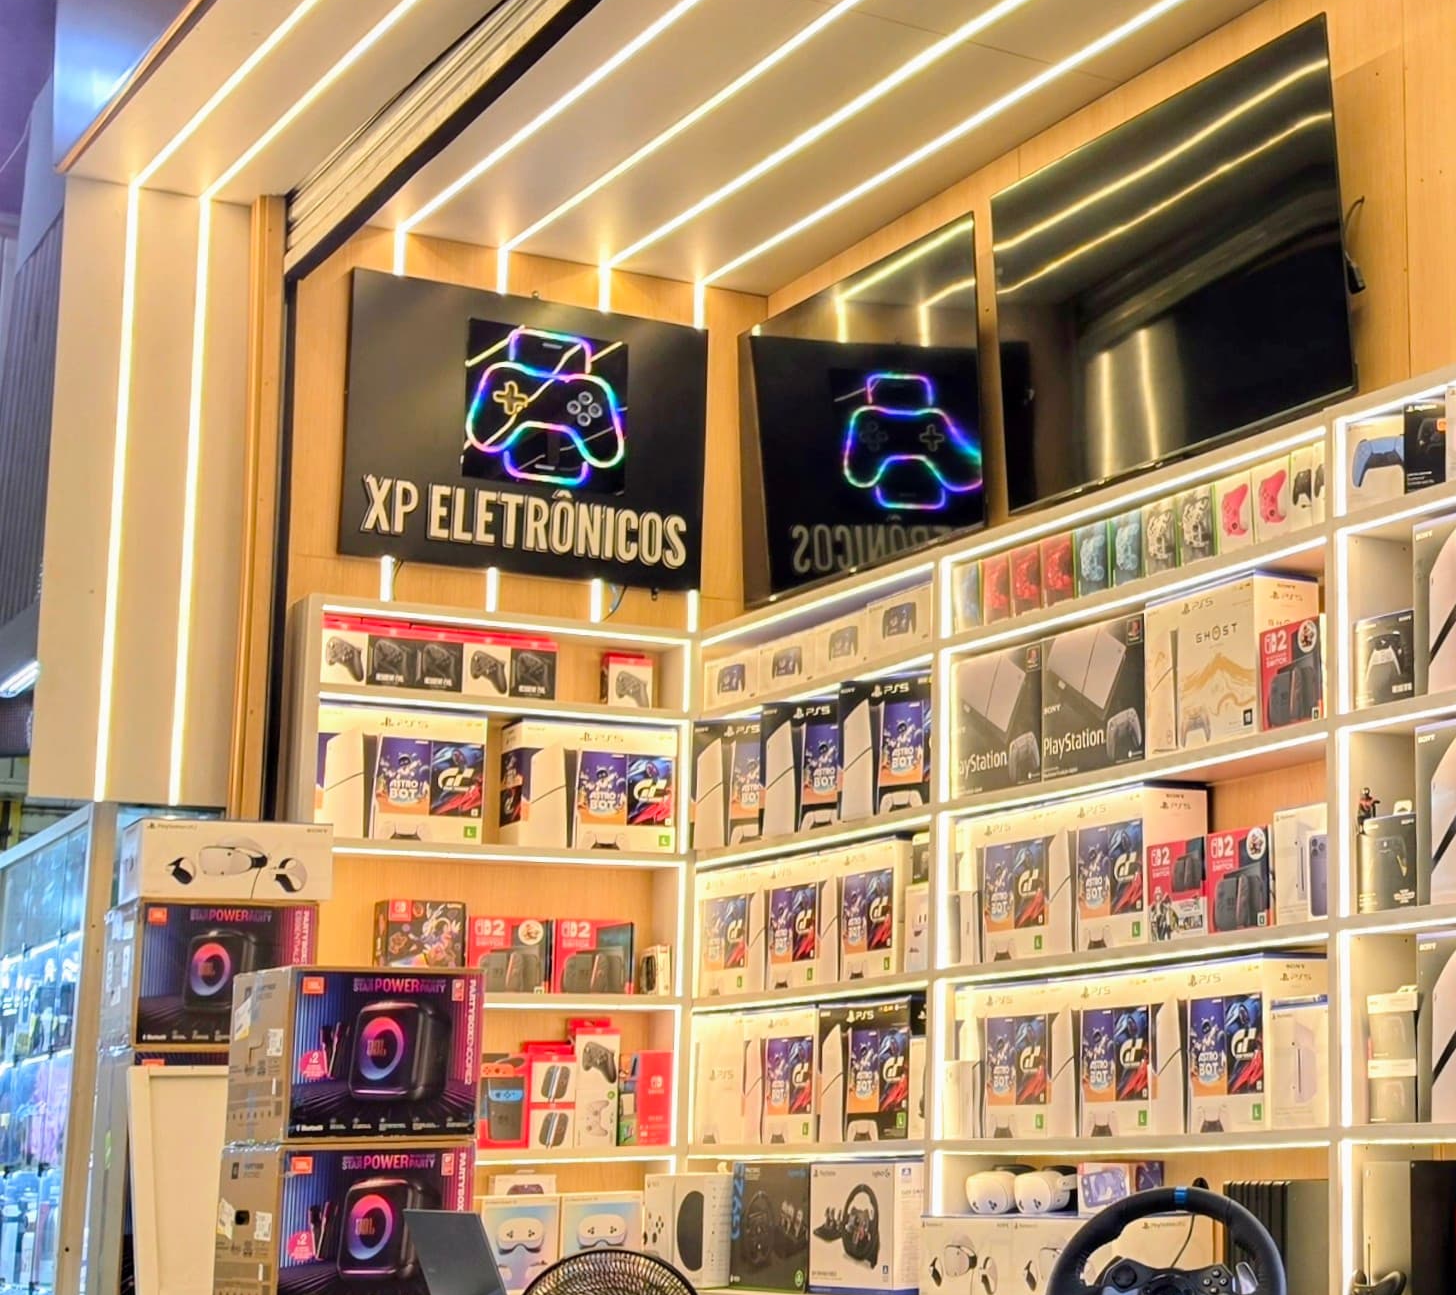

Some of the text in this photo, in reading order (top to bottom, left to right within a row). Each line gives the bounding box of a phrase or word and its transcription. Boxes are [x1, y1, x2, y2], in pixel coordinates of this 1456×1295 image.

[362, 474, 688, 570] XP ELETRÔNICOS
[1195, 623, 1238, 644] GHOST
[1277, 630, 1287, 651] 2
[884, 682, 910, 694] PS5
[804, 706, 831, 717] PS5
[1043, 728, 1106, 759] PlayStation
[891, 747, 914, 757] ASTRO
[891, 757, 914, 768] BOT
[958, 749, 1009, 779] ayStation
[813, 768, 835, 778] ASTRO
[389, 778, 418, 789] ASTRO
[813, 777, 835, 788] BOT
[389, 789, 417, 800] BOT
[589, 791, 615, 801] ASTRO
[589, 800, 615, 811] BOT
[1223, 835, 1235, 856] 2
[1161, 846, 1170, 866] 2
[208, 909, 250, 922] POWER
[492, 919, 506, 936] 2
[577, 921, 591, 938] 2
[374, 978, 420, 993] POWER
[856, 1010, 875, 1021] PS5
[1199, 1061, 1219, 1076] BOT
[363, 1154, 409, 1171] POWER
